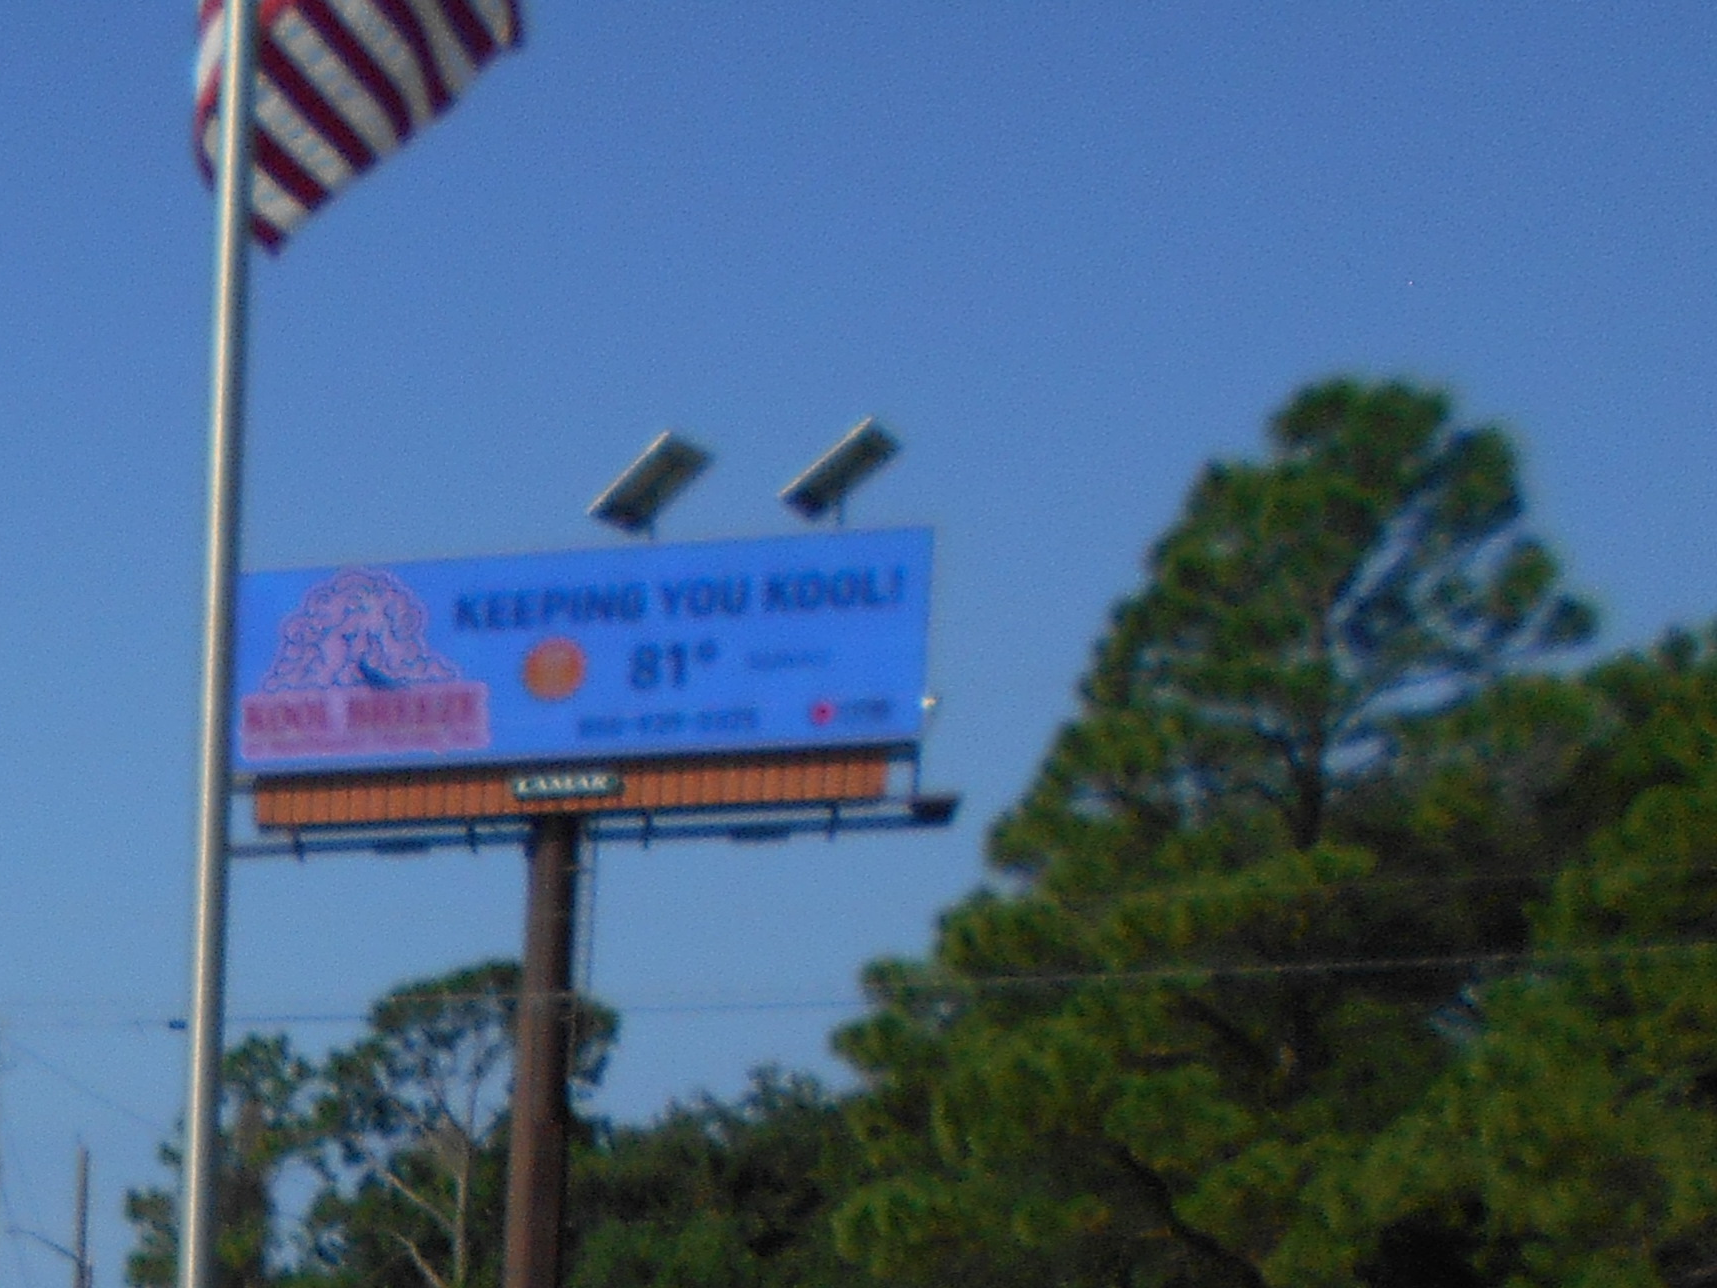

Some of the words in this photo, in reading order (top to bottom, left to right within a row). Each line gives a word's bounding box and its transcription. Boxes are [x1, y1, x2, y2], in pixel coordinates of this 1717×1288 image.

[453, 582, 647, 630] KEEPING
[659, 574, 752, 618] YOU
[762, 564, 905, 614] KOOL!
